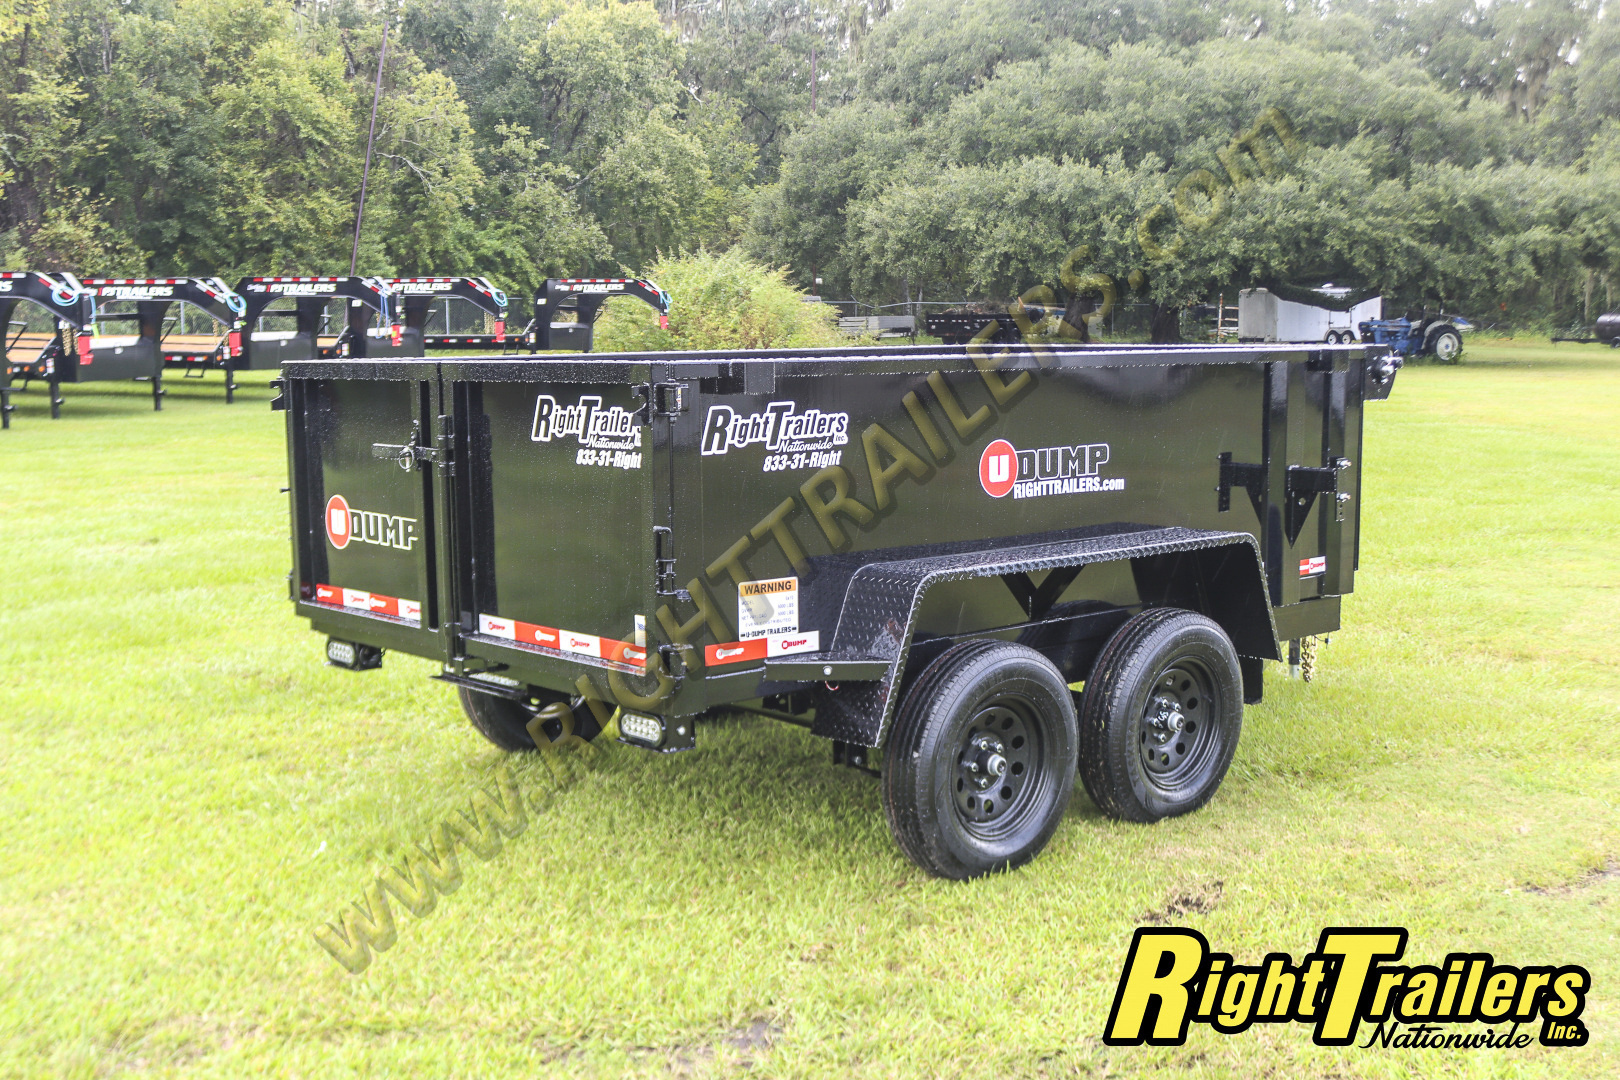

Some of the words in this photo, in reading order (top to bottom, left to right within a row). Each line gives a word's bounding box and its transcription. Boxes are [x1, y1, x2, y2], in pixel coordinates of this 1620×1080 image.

[586, 435, 634, 450] Nationwide
[775, 437, 834, 453] Nationwide
[576, 449, 642, 469] 833-31-Right
[762, 450, 842, 472] 833-31-Right
[1013, 478, 1125, 498] RIGHTTRAILERS.com
[744, 580, 792, 595] WARNING
[767, 626, 792, 635] TRAILERS
